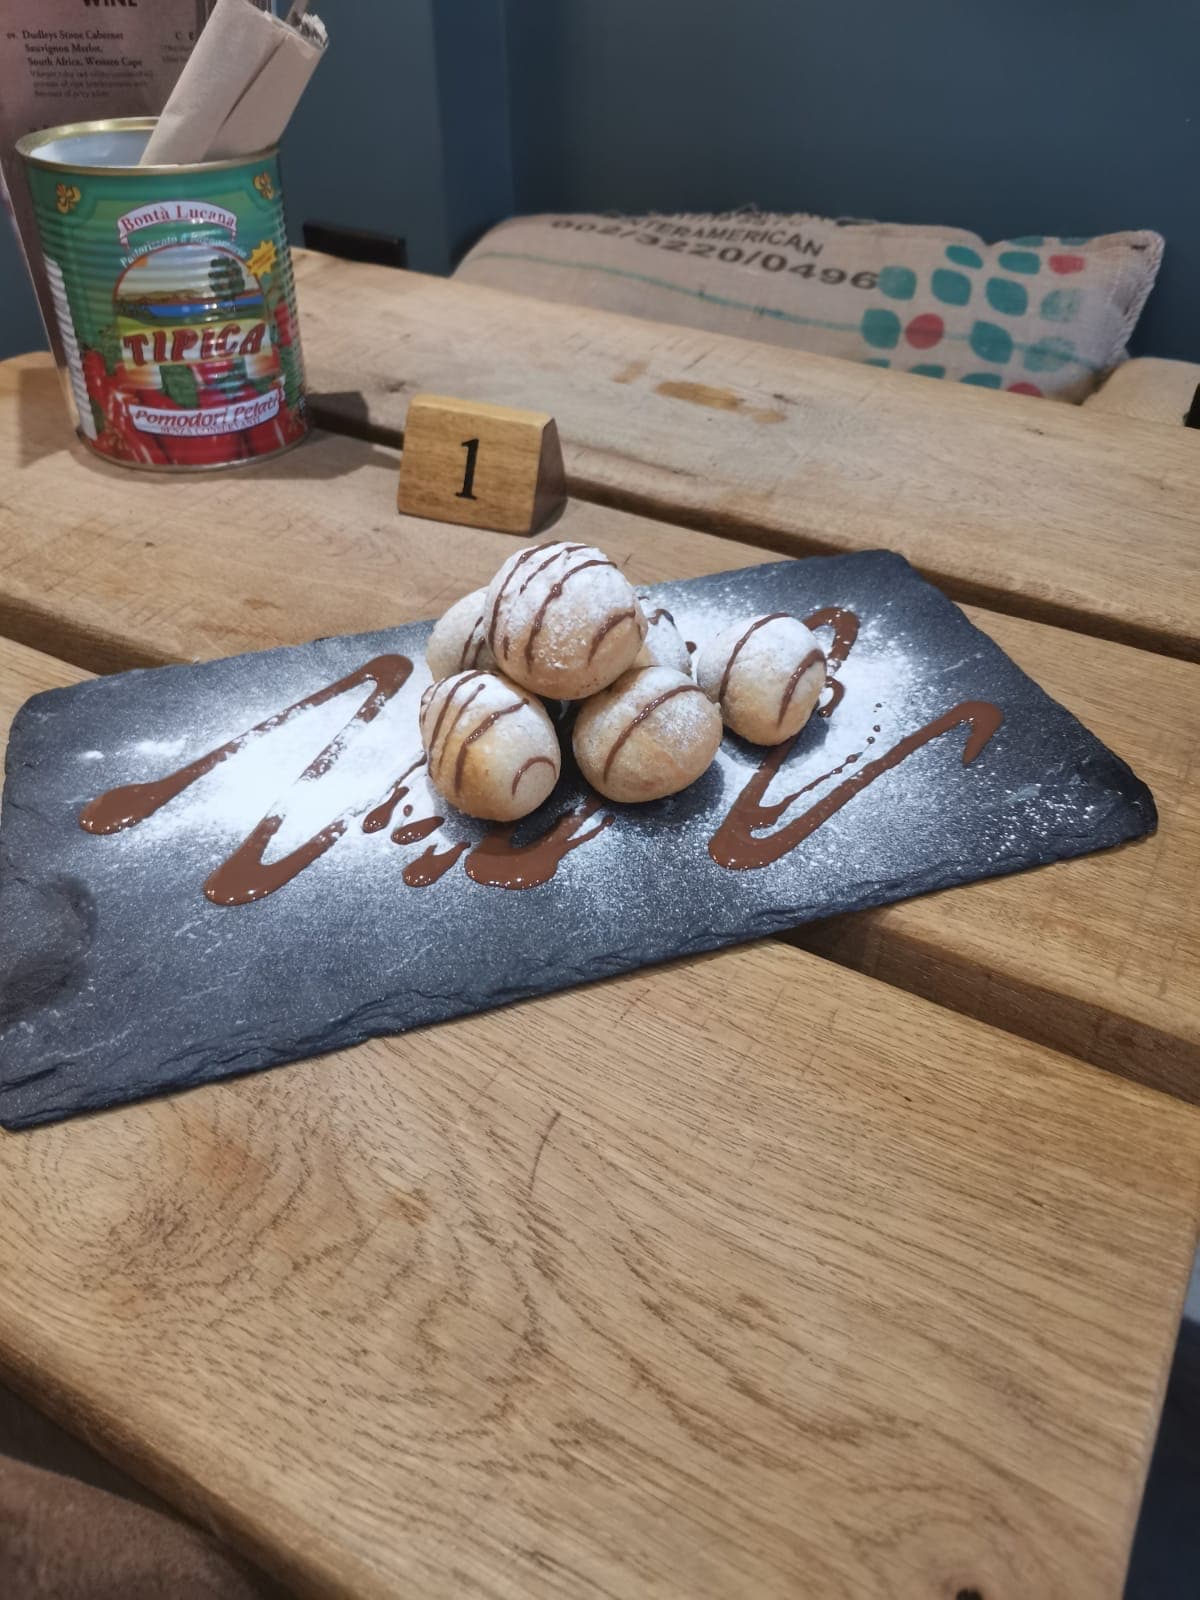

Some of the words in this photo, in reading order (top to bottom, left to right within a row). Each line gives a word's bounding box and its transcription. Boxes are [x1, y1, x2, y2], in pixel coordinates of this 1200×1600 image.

[176, 204, 235, 227] Lucana
[123, 322, 266, 367] TIPICA
[135, 407, 229, 428] Pomodori
[233, 396, 278, 422] Pelati
[454, 437, 480, 501] 1
